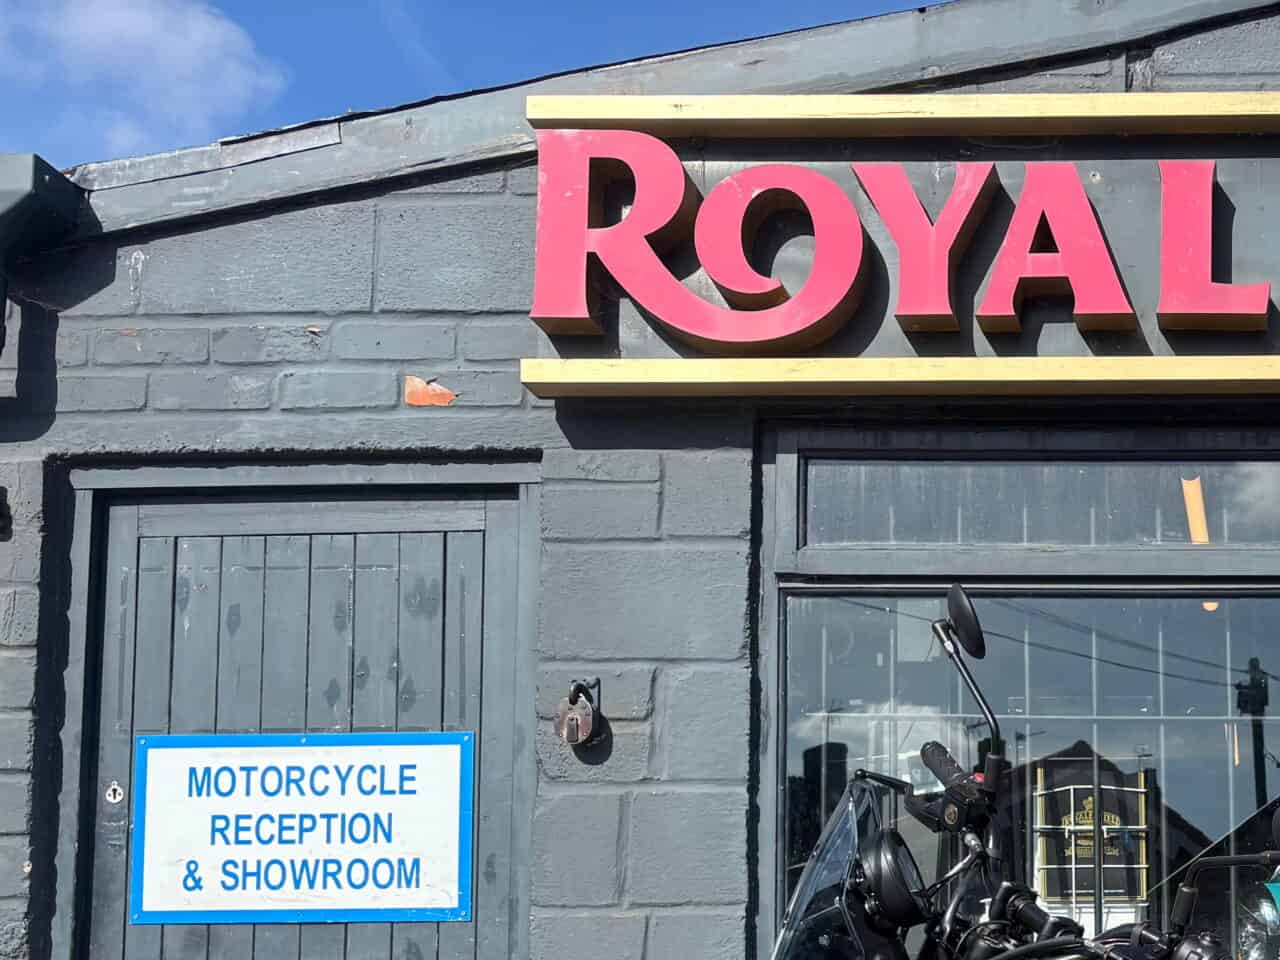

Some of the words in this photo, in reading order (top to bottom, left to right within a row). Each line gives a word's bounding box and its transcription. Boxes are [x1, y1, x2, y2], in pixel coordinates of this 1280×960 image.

[529, 128, 1272, 344] ROYAL
[187, 764, 417, 798] MOTORCYCLE
[210, 812, 393, 846] RECEPTION
[182, 859, 204, 891] &
[220, 857, 421, 891] SHOWROOM
